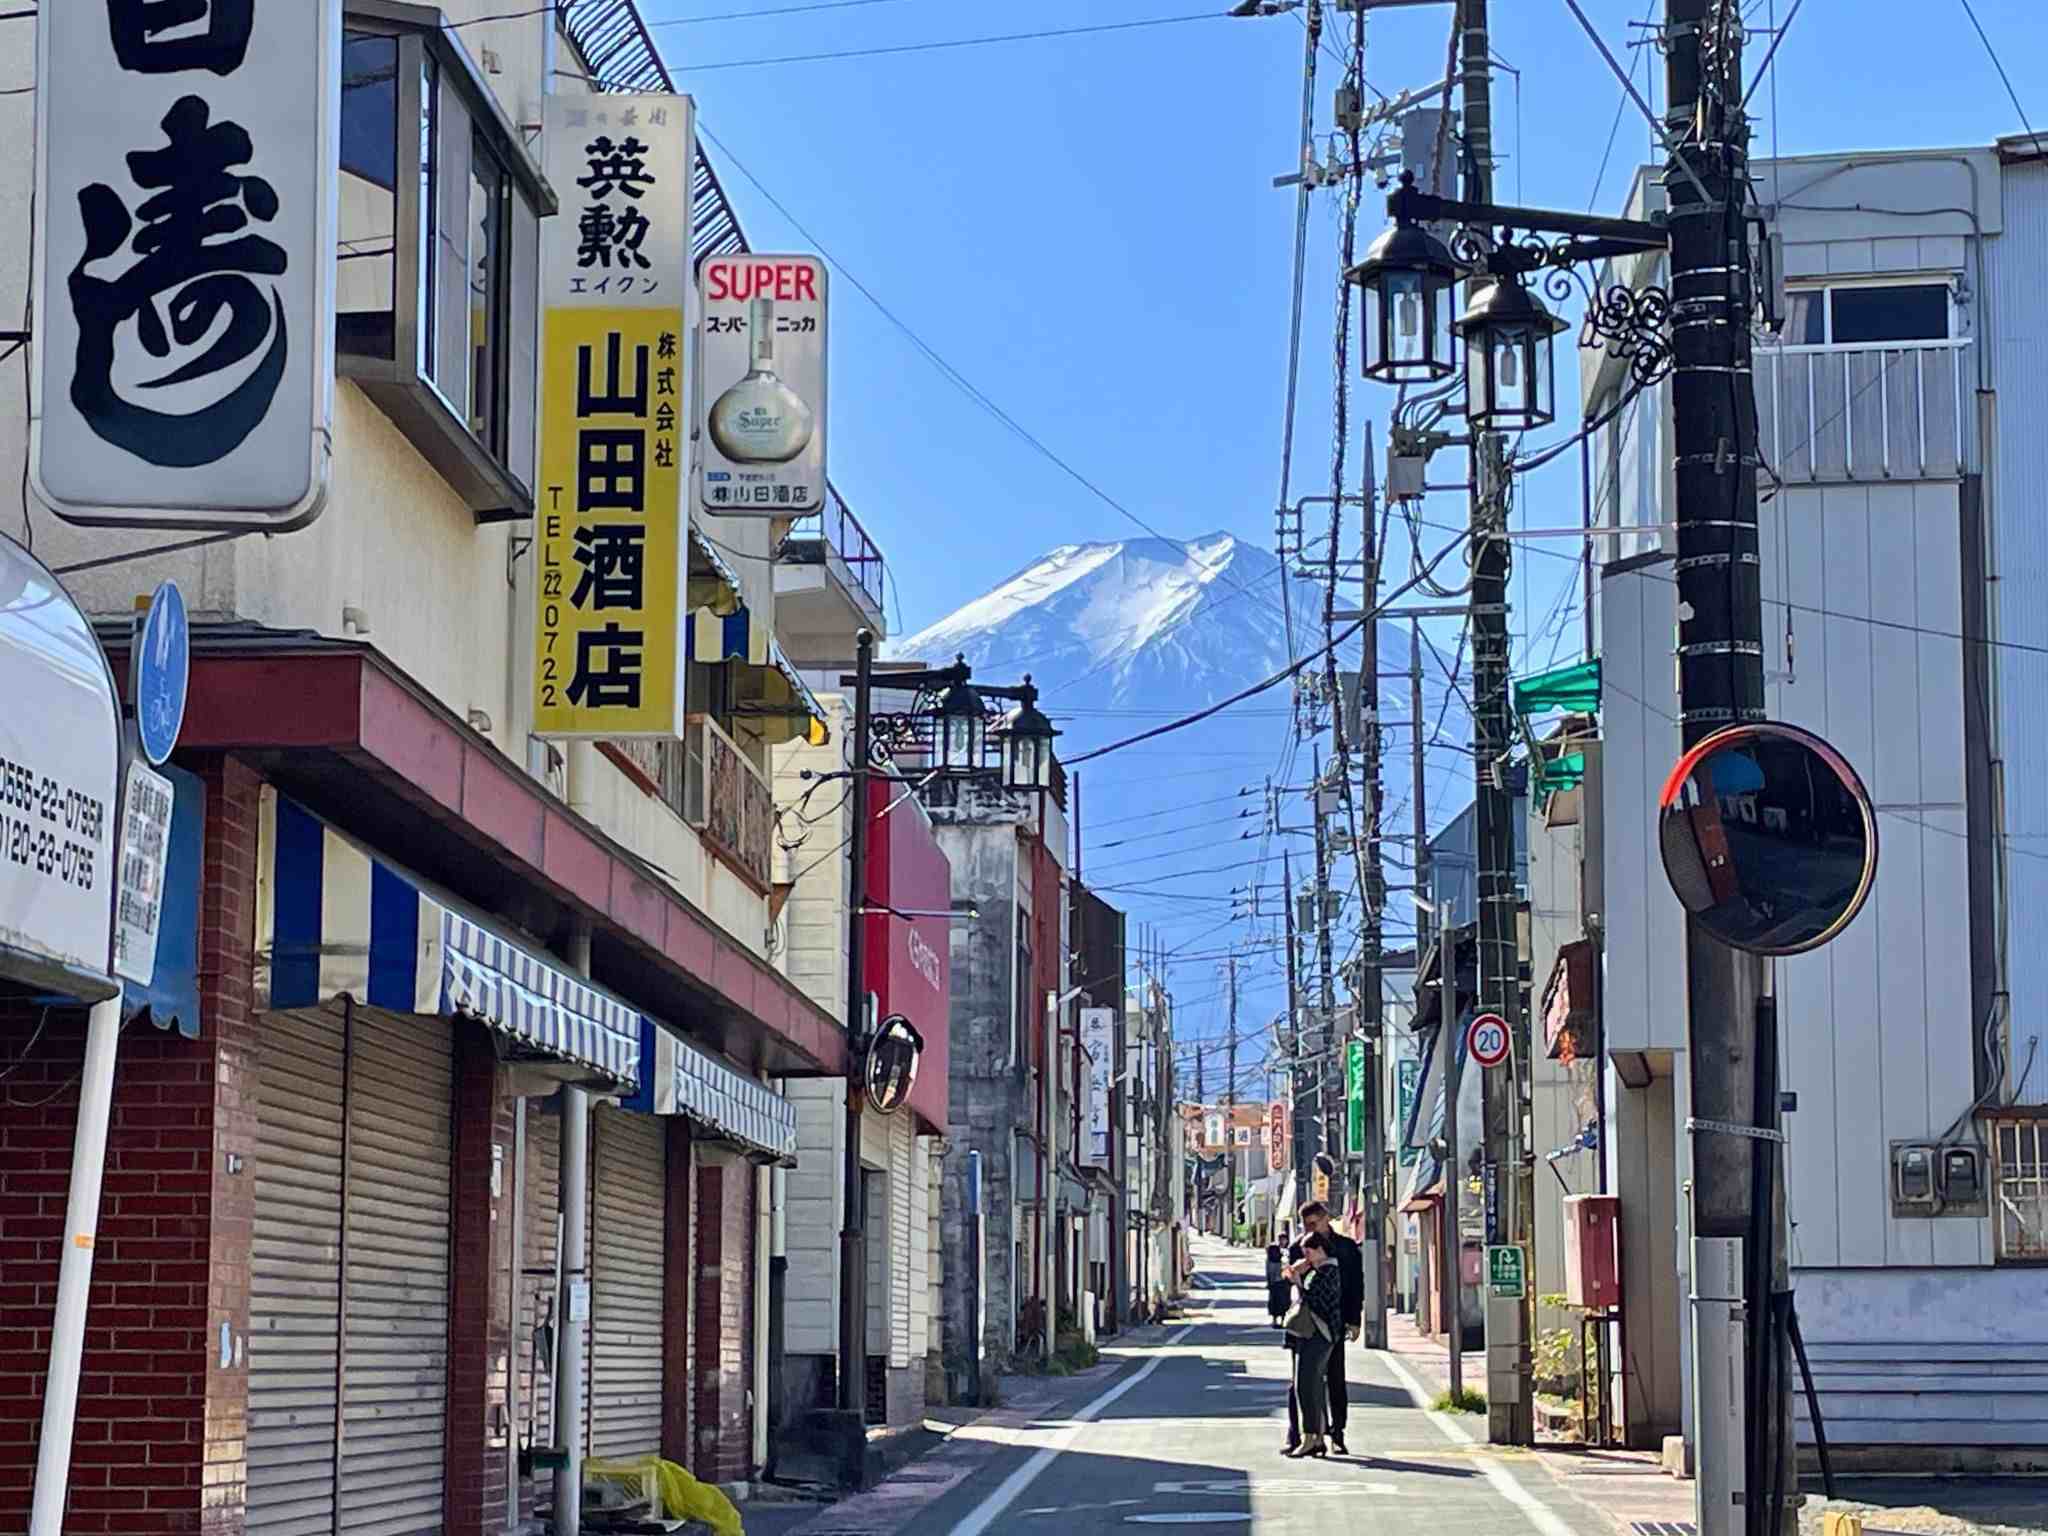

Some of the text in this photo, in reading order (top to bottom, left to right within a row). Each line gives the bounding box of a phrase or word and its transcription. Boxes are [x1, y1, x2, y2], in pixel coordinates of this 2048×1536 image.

[569, 276, 659, 295] エイクン
[707, 264, 817, 303] SUPER
[706, 316, 816, 333] スーパー ニッカ
[655, 331, 676, 468] 株式会社
[566, 332, 648, 709] 山田酒店
[1478, 1030, 1501, 1052] 20
